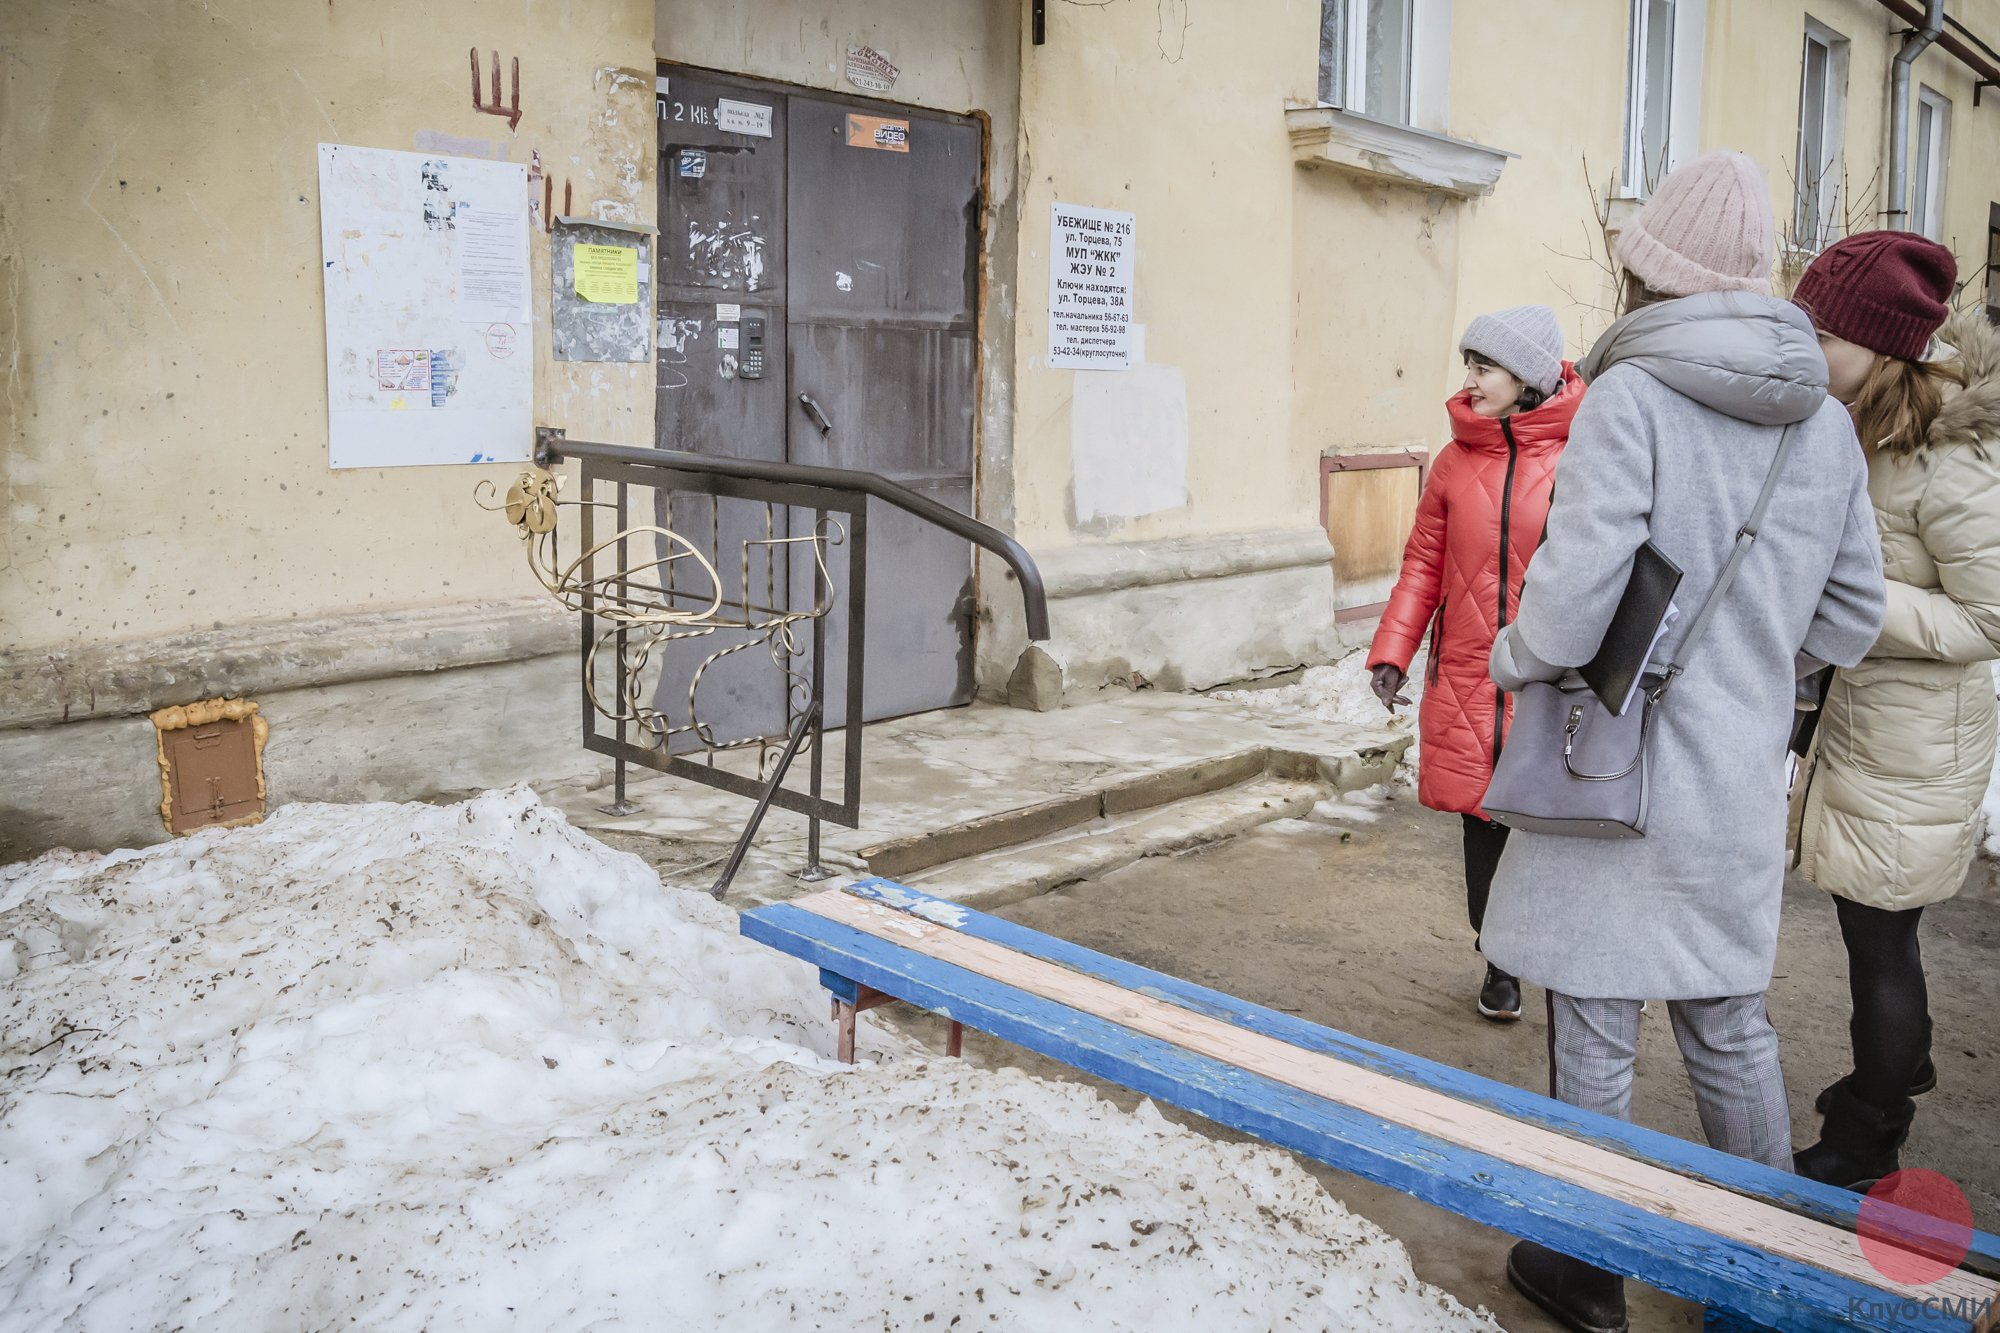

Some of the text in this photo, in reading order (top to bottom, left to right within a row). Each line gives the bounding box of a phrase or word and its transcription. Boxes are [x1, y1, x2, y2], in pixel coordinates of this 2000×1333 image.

[674, 102, 684, 121] 2
[874, 129, 905, 141] ВИДЕО
[1057, 215, 1131, 235] УБЕЖИЩЕ № 216
[1065, 232, 1122, 248] ул. Торцева, 75
[1066, 246, 1088, 260] МУП
[1070, 262, 1115, 277] ЖЭУ № 2
[1057, 278, 1127, 295] Ключи находятся:
[1058, 293, 1124, 307] ул. Торцева, 38А
[1056, 323, 1069, 332] тел.
[1070, 324, 1100, 334] мастеров
[1066, 335, 1116, 347] тел. диспетчера
